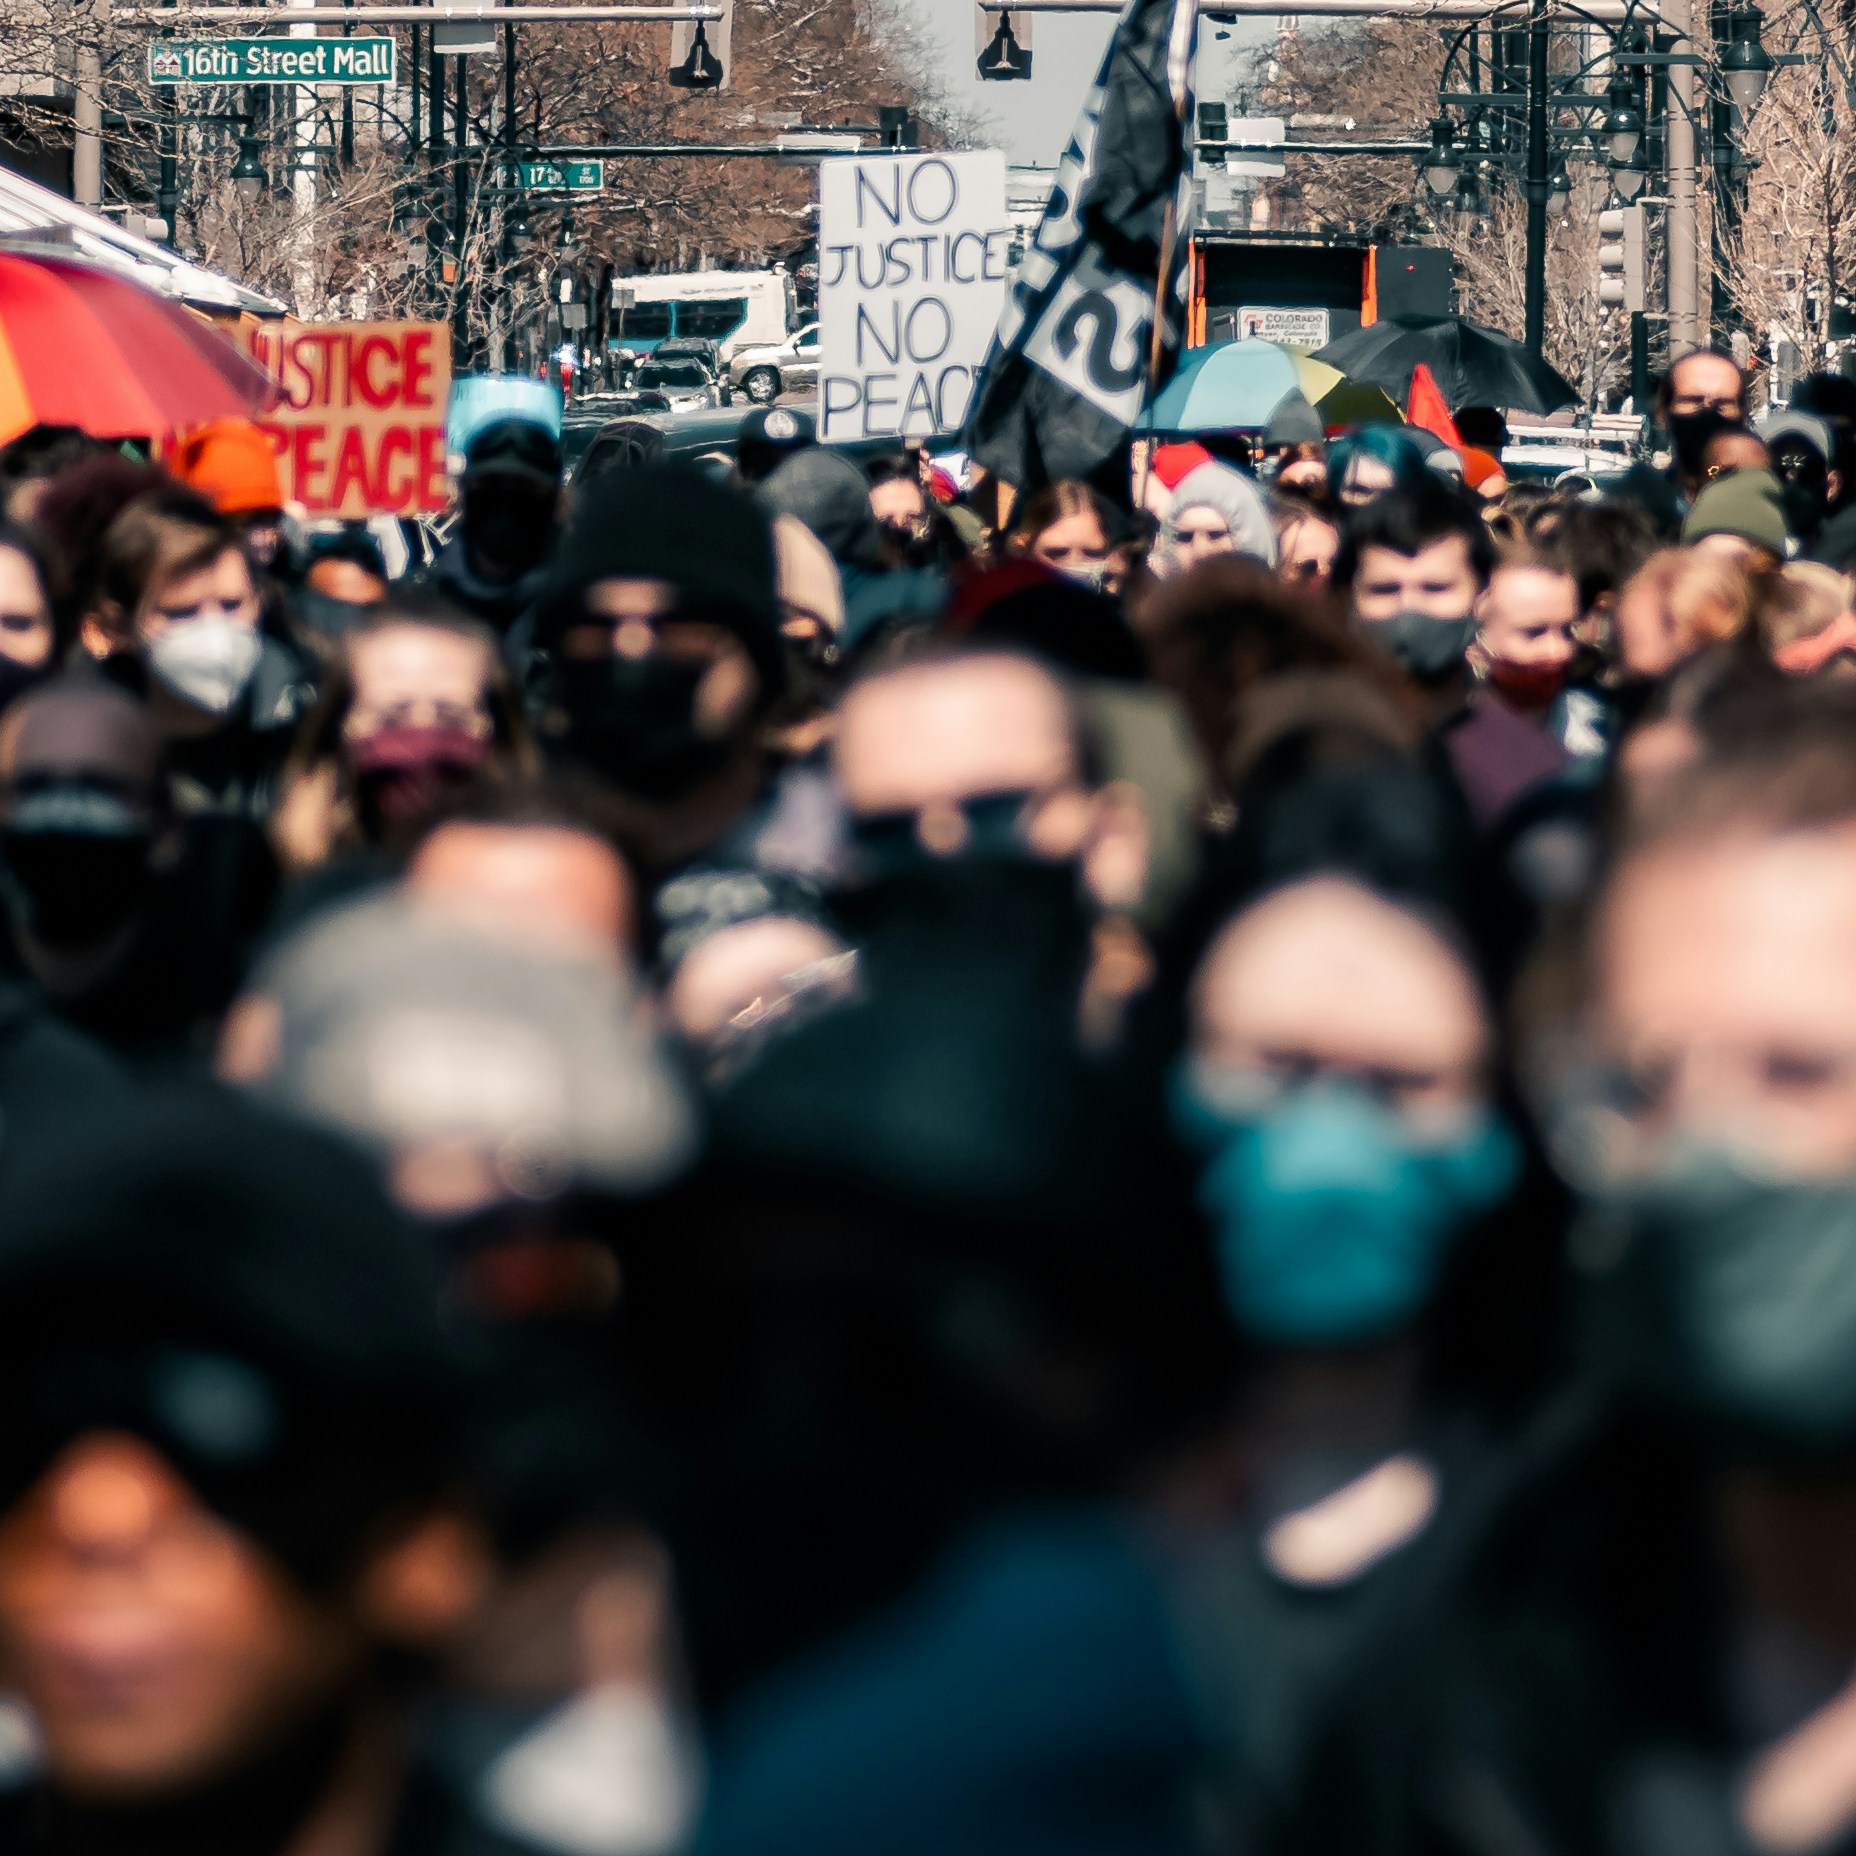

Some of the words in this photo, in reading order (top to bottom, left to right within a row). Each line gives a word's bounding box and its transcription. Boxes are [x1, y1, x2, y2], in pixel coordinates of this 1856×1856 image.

[182, 45, 239, 76] 16th
[245, 44, 327, 77] Street
[332, 42, 390, 76] Mall
[855, 158, 959, 228] NO
[823, 230, 1006, 290] JUSTICE
[855, 296, 953, 368] NO
[1265, 313, 1323, 323] COLORADO
[251, 329, 433, 411] USTICE
[822, 364, 978, 437] PEAC
